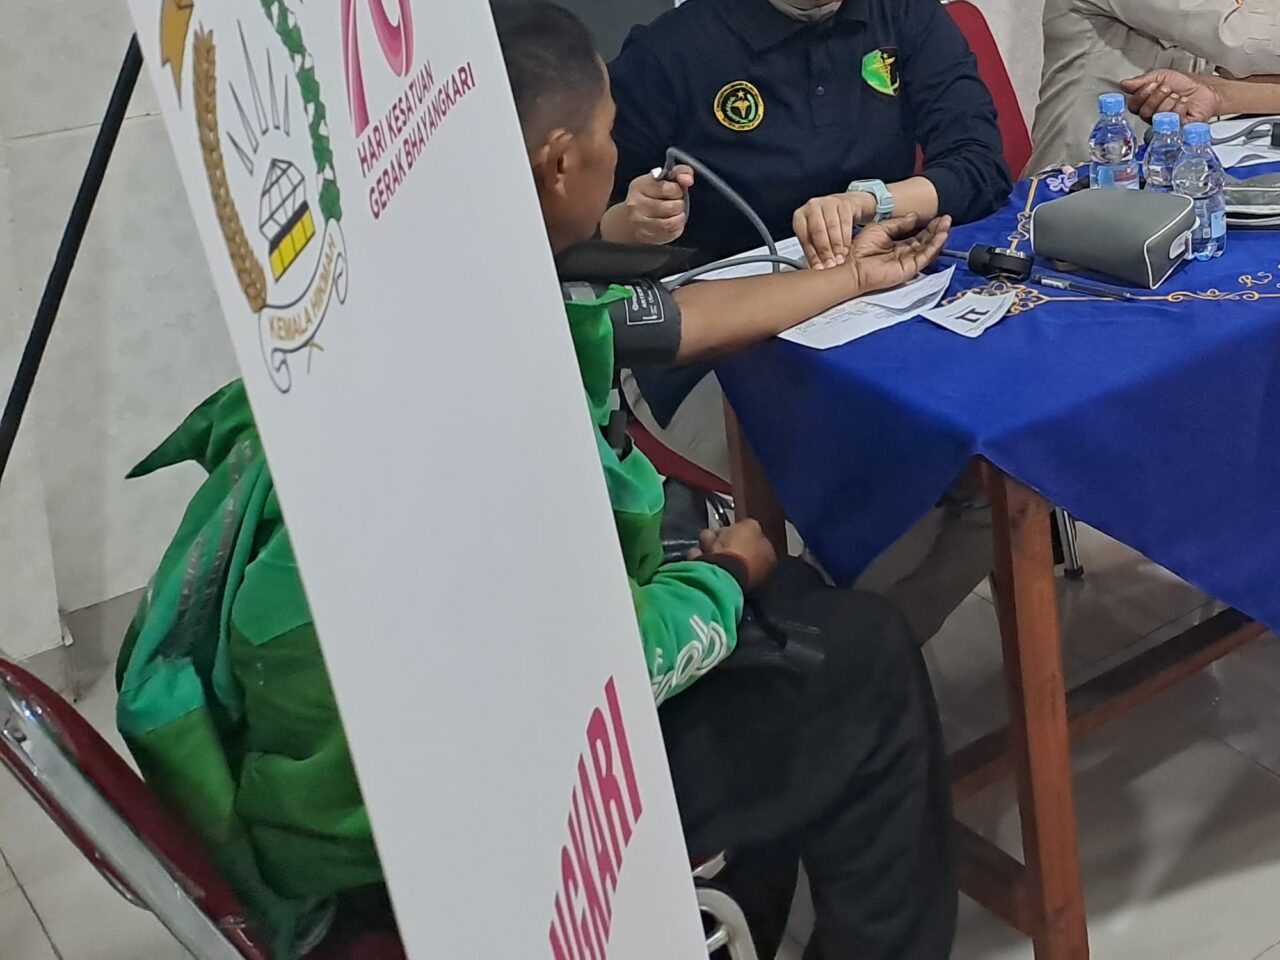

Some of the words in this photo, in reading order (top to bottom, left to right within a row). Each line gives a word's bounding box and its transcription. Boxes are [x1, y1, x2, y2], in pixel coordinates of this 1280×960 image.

[357, 119, 389, 179] HARI
[384, 58, 435, 145] KESATUAN
[368, 147, 407, 220] GERAK
[402, 60, 477, 171] BHAYANGKARI
[1238, 271, 1273, 288] RS
[550, 674, 643, 960] GKARI
